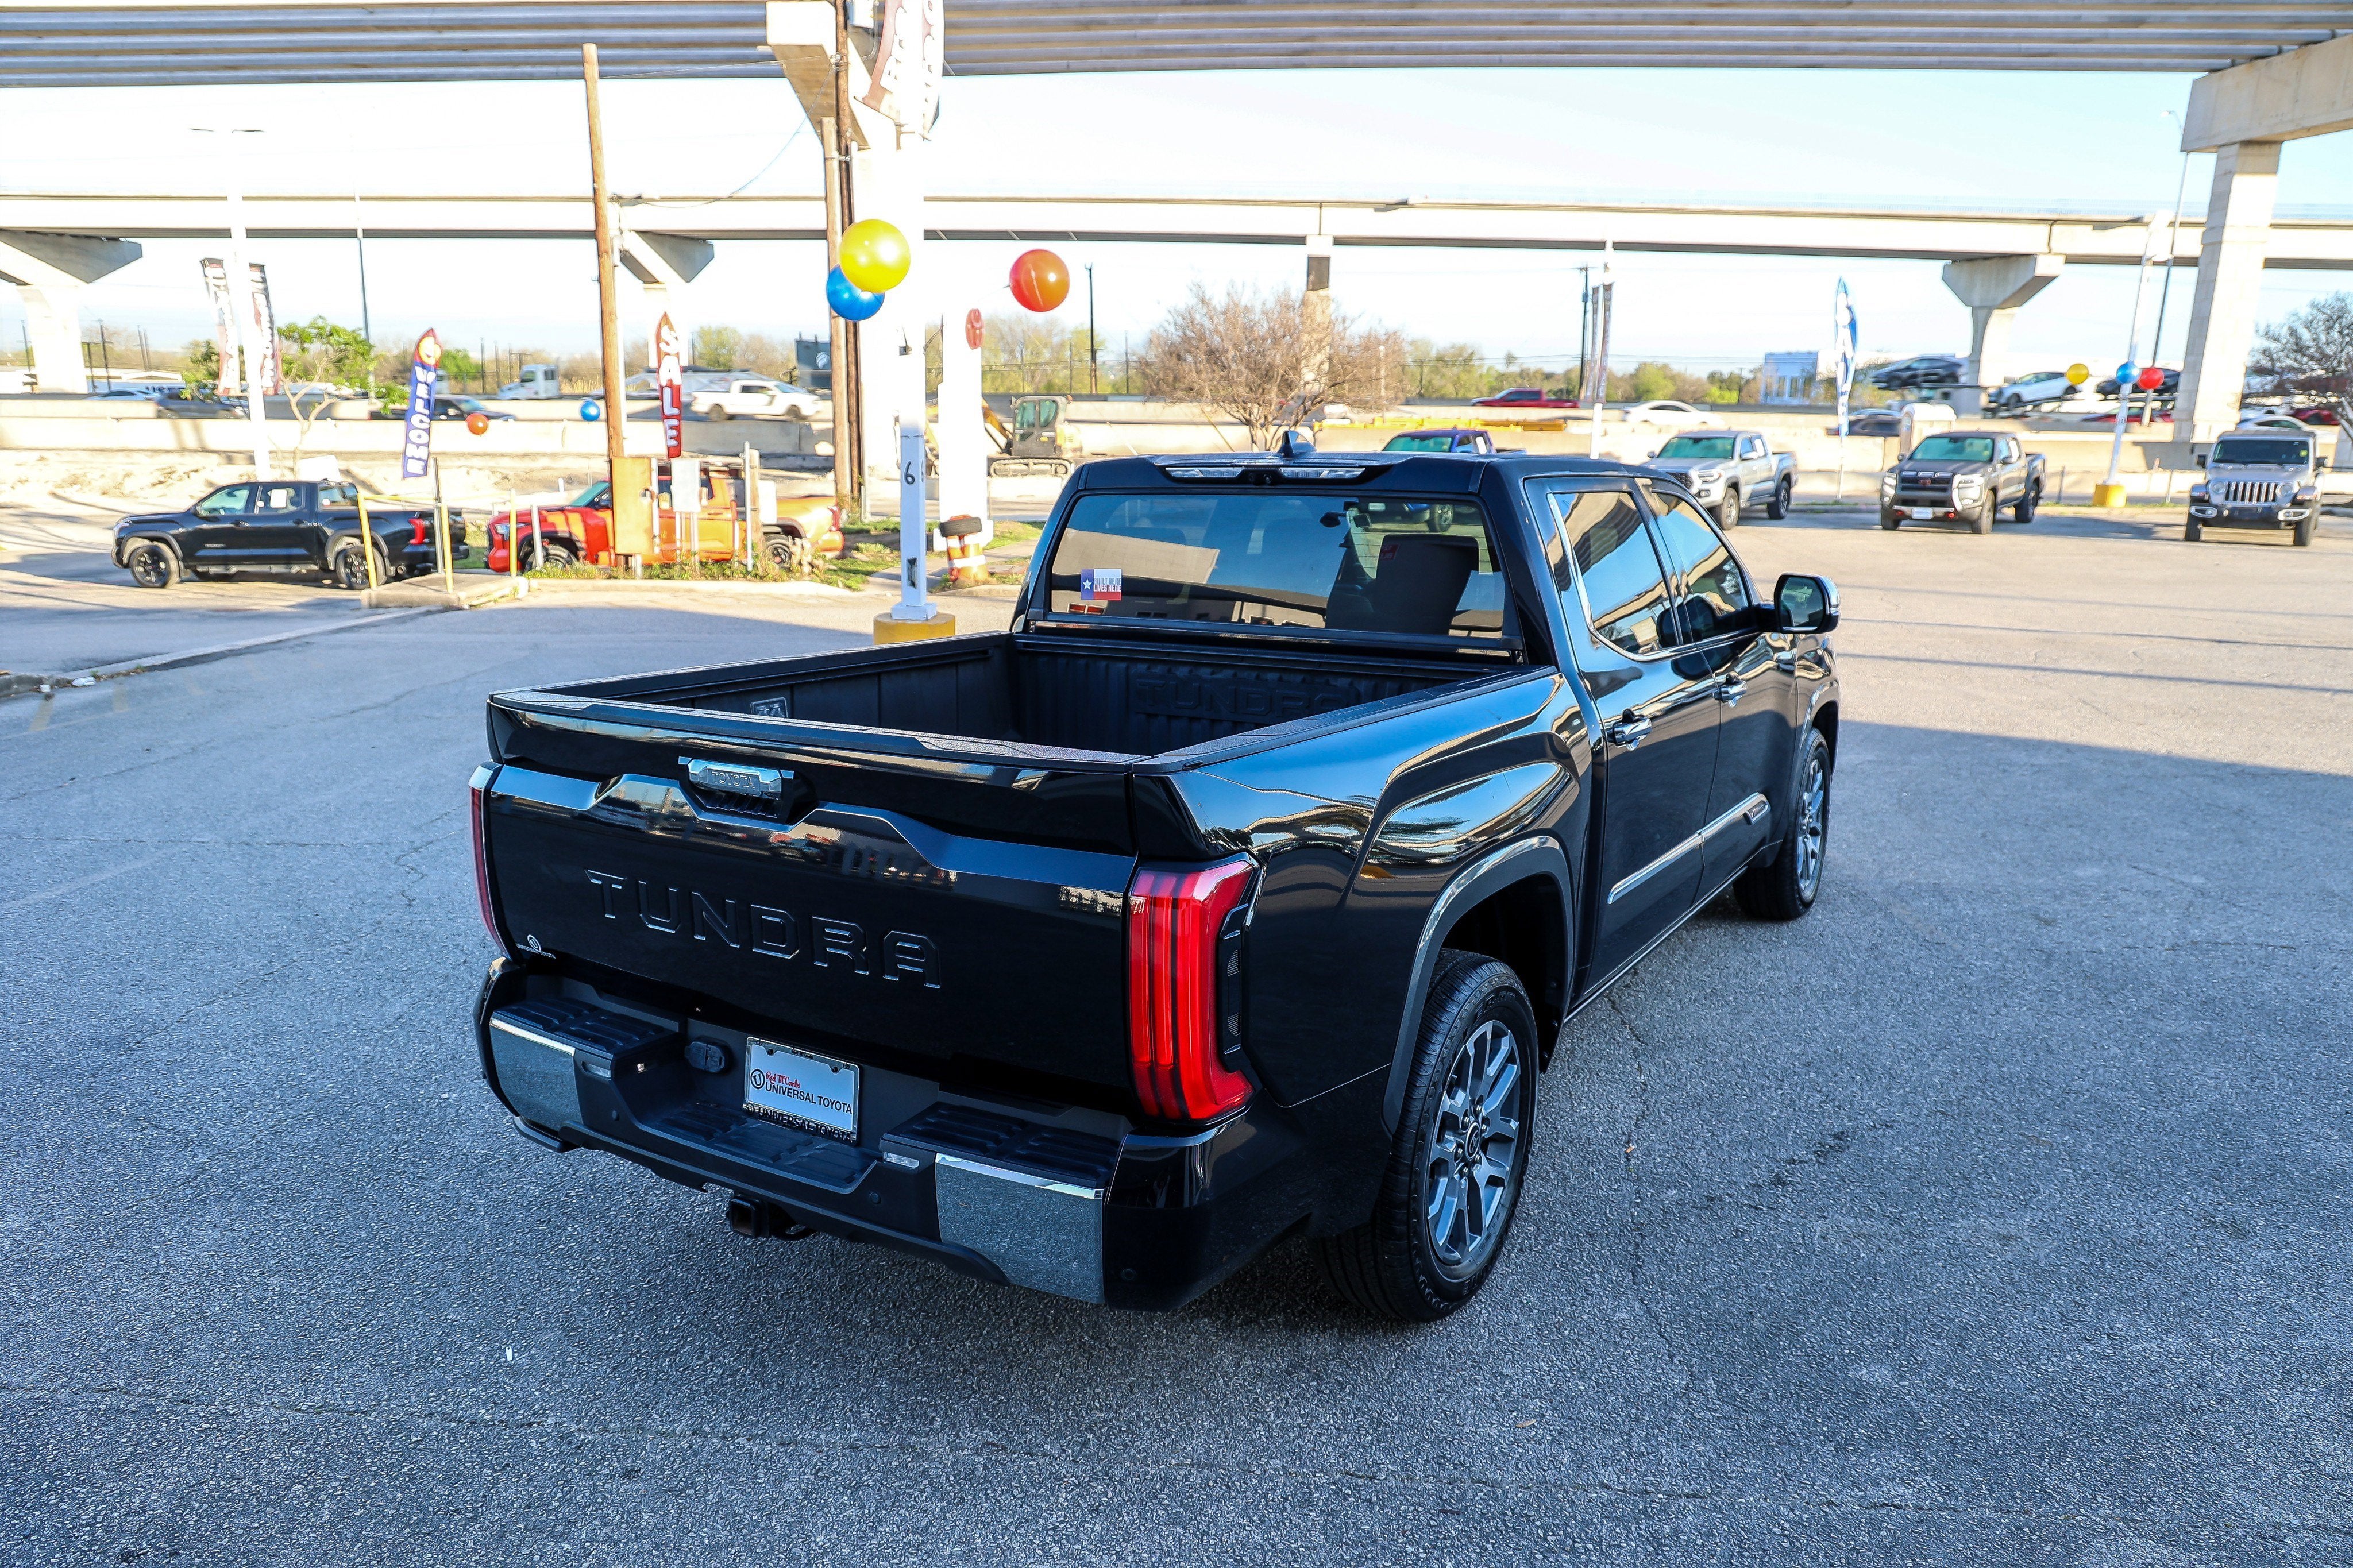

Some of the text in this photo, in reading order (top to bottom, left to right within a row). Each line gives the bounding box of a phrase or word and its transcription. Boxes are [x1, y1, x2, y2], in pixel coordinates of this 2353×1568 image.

[659, 325, 682, 447] SALE
[406, 366, 437, 475] WELCOME
[904, 461, 915, 485] 6
[711, 771, 755, 789] TOYOTA
[584, 868, 940, 988] TUNDRA
[766, 1071, 800, 1089] Red McCombs
[766, 1082, 853, 1115] UNIVERSAL TOYOTA
[759, 1107, 853, 1142] UNIVERSAL TOYOTA
